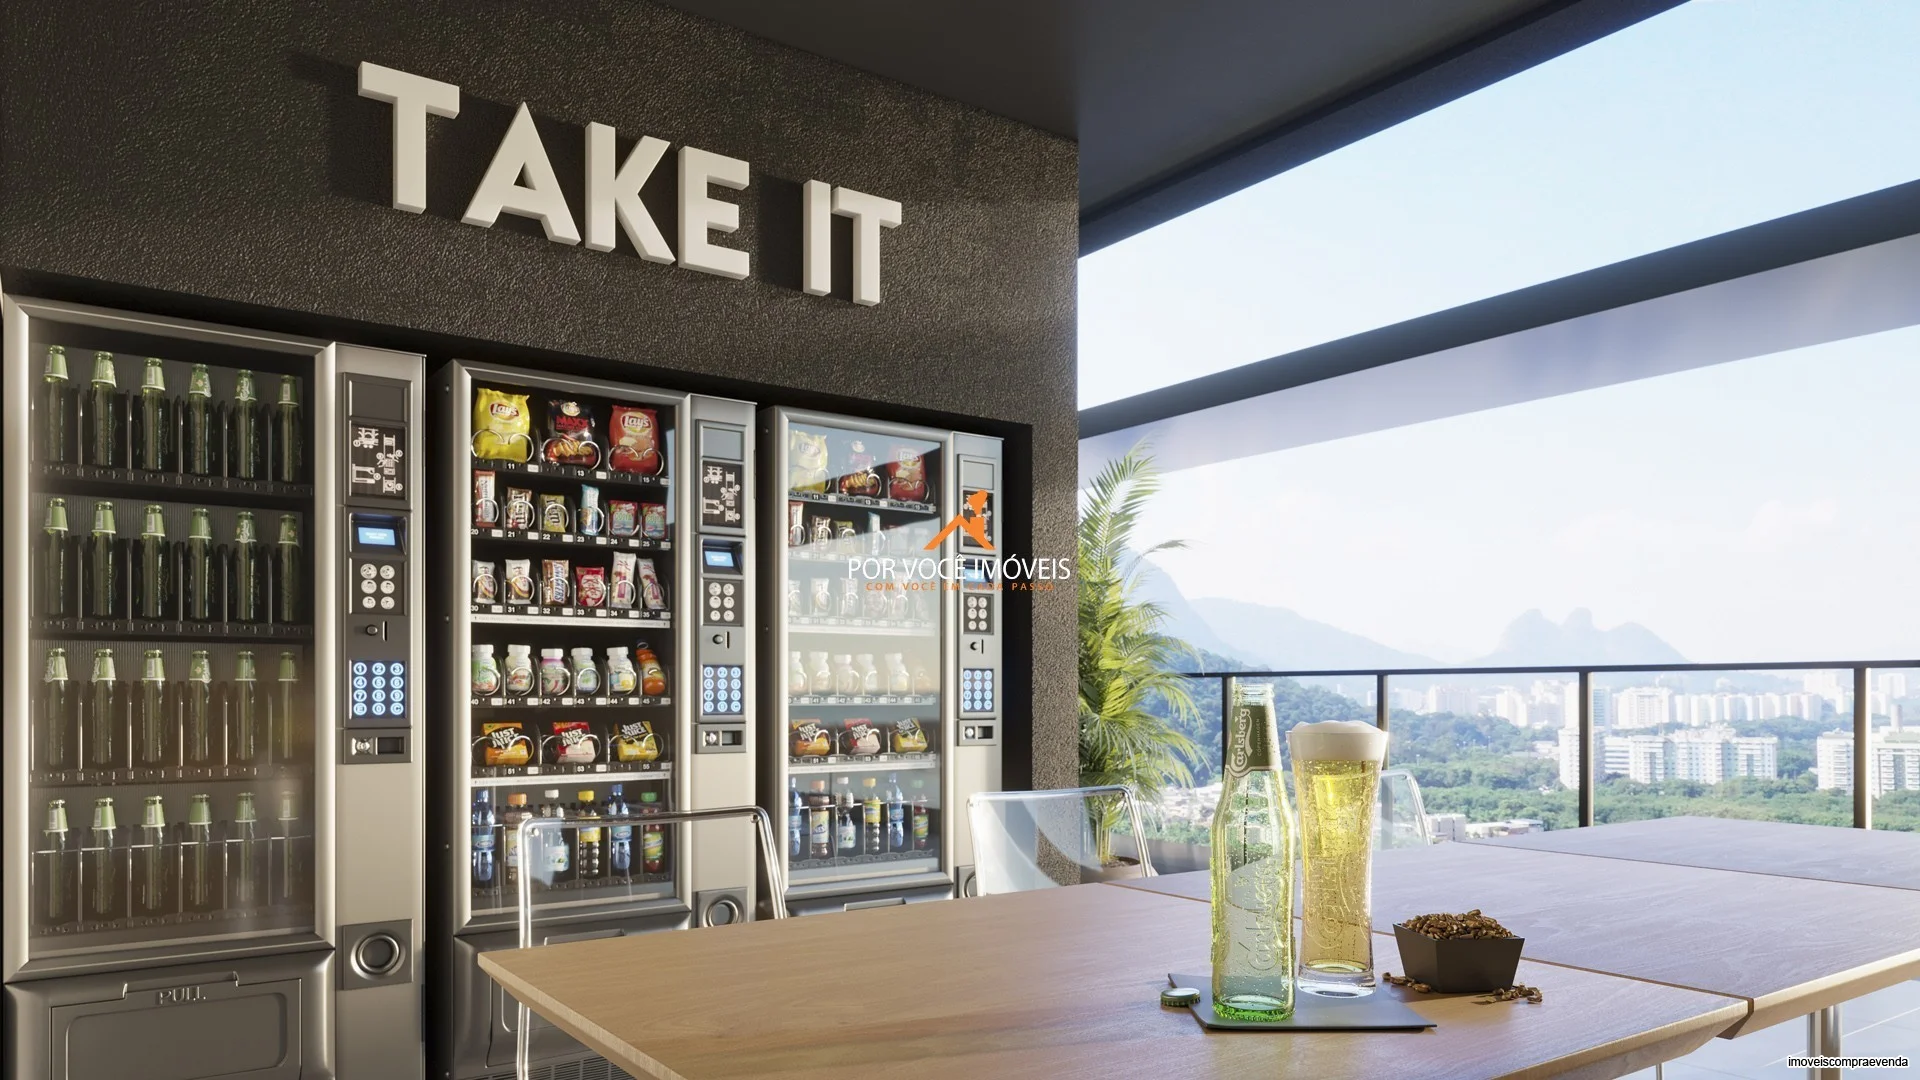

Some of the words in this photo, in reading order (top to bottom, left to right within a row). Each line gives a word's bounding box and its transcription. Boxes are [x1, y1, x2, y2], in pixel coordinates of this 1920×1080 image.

[358, 61, 750, 280] TAKE
[803, 179, 902, 307] IT
[623, 414, 651, 430] Lay's
[491, 727, 515, 740] JUST
[561, 728, 583, 740] JUST
[622, 721, 642, 734] JUST
[1230, 708, 1252, 772] Carlsberg
